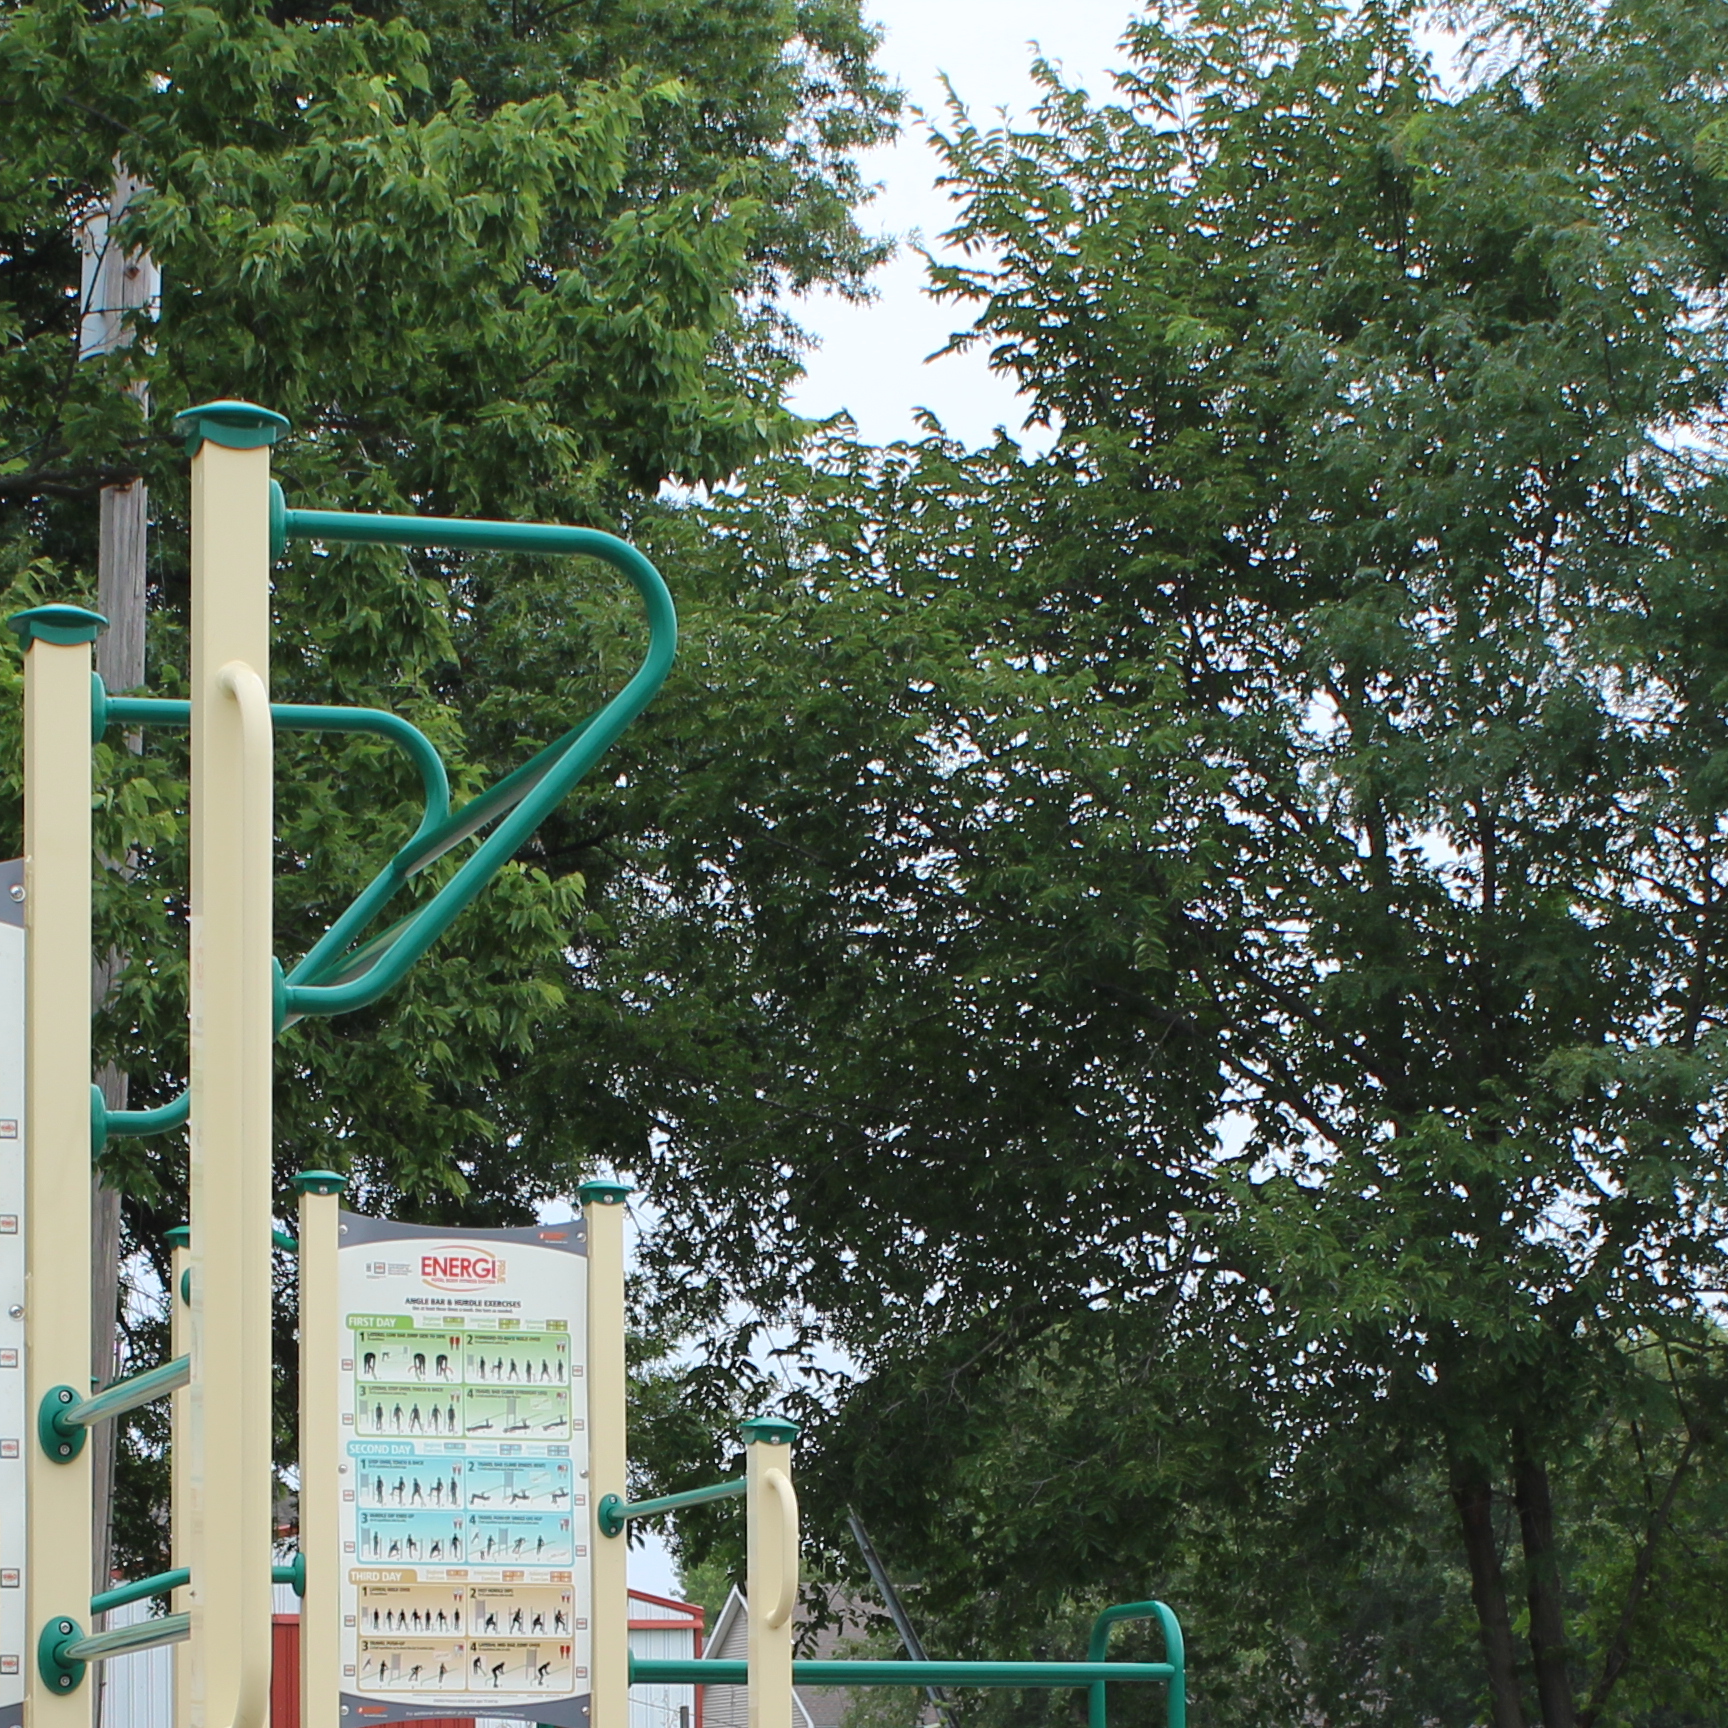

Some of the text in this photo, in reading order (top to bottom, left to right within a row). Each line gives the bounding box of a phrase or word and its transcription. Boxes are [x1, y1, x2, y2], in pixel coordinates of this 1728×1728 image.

[421, 1256, 496, 1279] ENERGI
[349, 1316, 397, 1328] FIRST DAY
[349, 1443, 412, 1455] SECOND DAY
[351, 1571, 402, 1582] THIRD DAY
